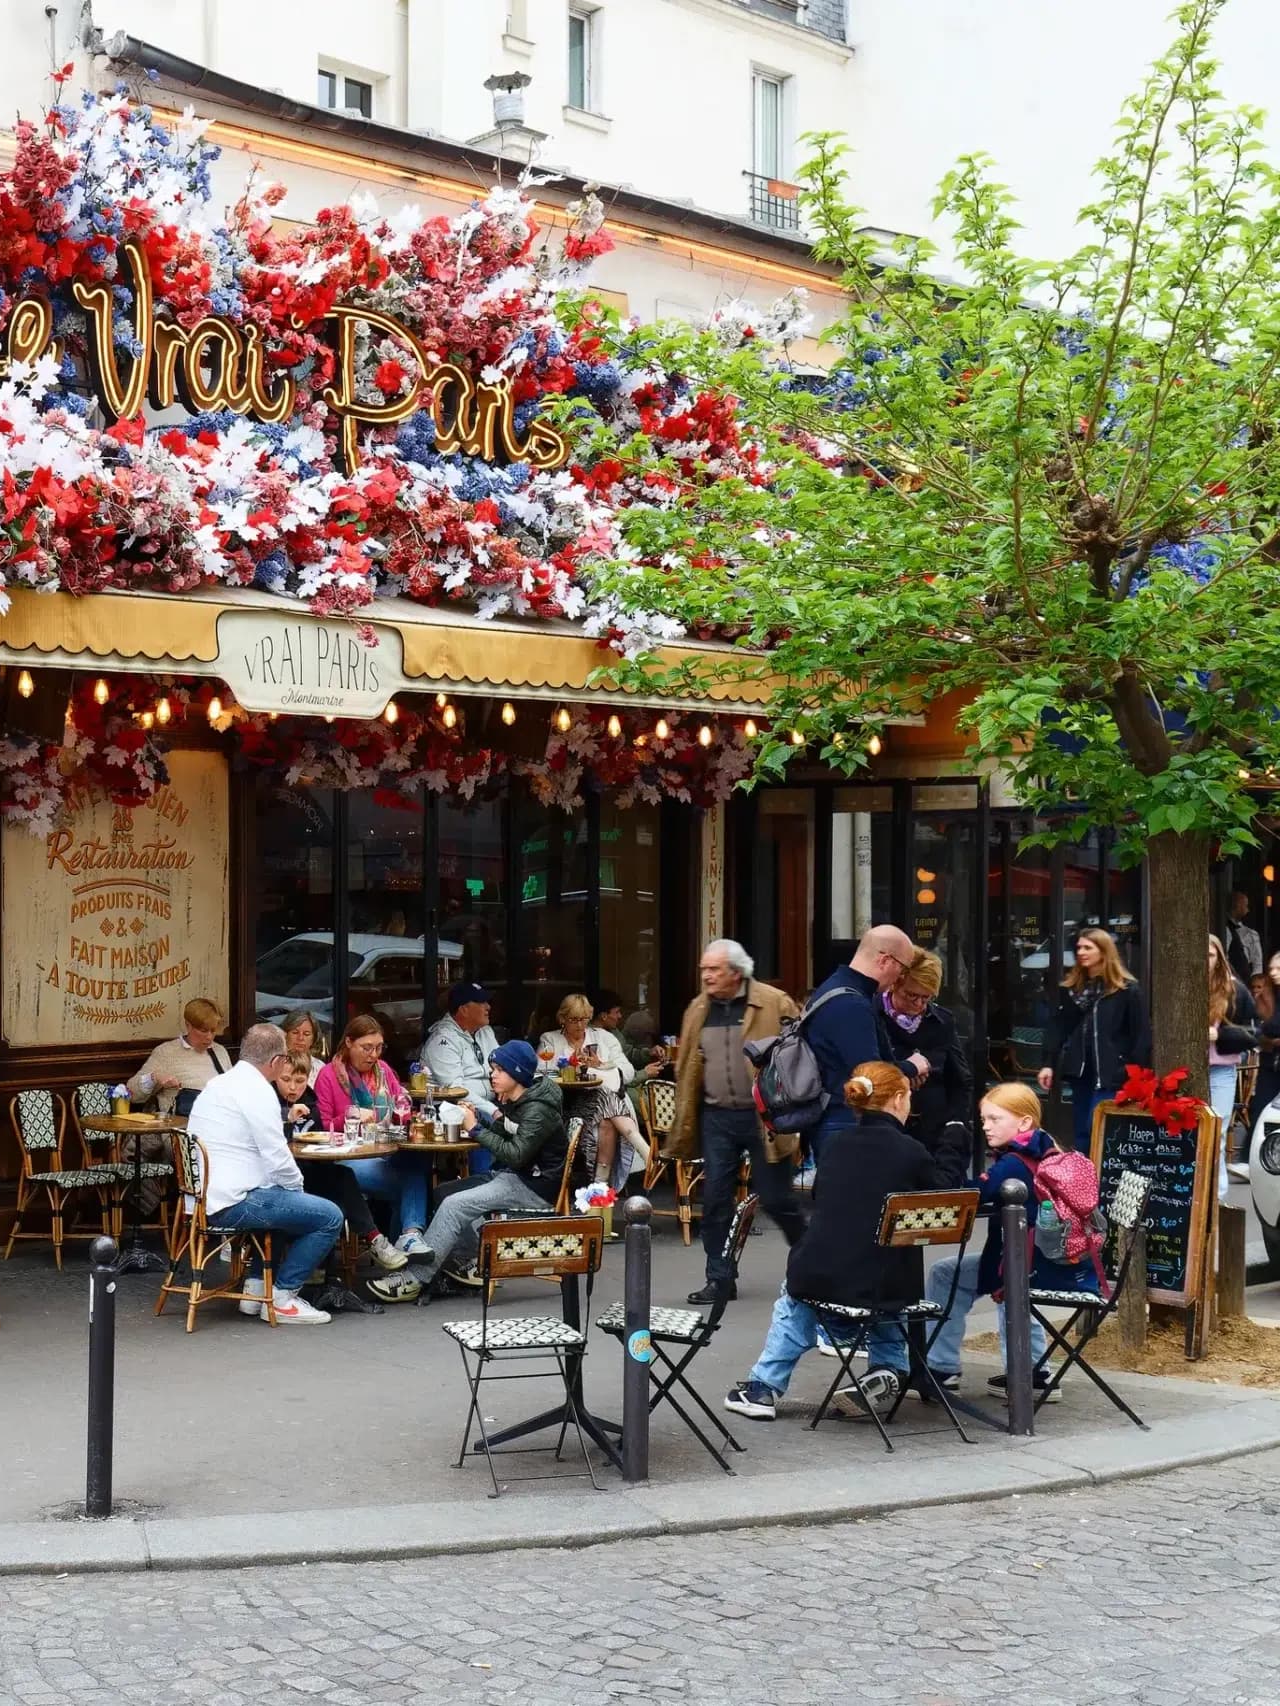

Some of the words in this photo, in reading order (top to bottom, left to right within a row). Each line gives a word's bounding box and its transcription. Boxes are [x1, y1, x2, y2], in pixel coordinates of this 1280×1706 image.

[72, 240, 304, 426] Vrai
[320, 303, 570, 476] Paris
[244, 625, 304, 686] VRAI
[316, 626, 380, 693] PARIS
[280, 687, 345, 707] Montmartre
[47, 828, 194, 876] Restauration
[71, 892, 134, 923] PRODUITS
[137, 893, 172, 921] FRAIS
[115, 916, 128, 938] &
[70, 935, 108, 969] FAIT
[110, 933, 170, 970] MAISON
[65, 970, 128, 1001] TOUTE
[132, 956, 191, 998] HEURE
